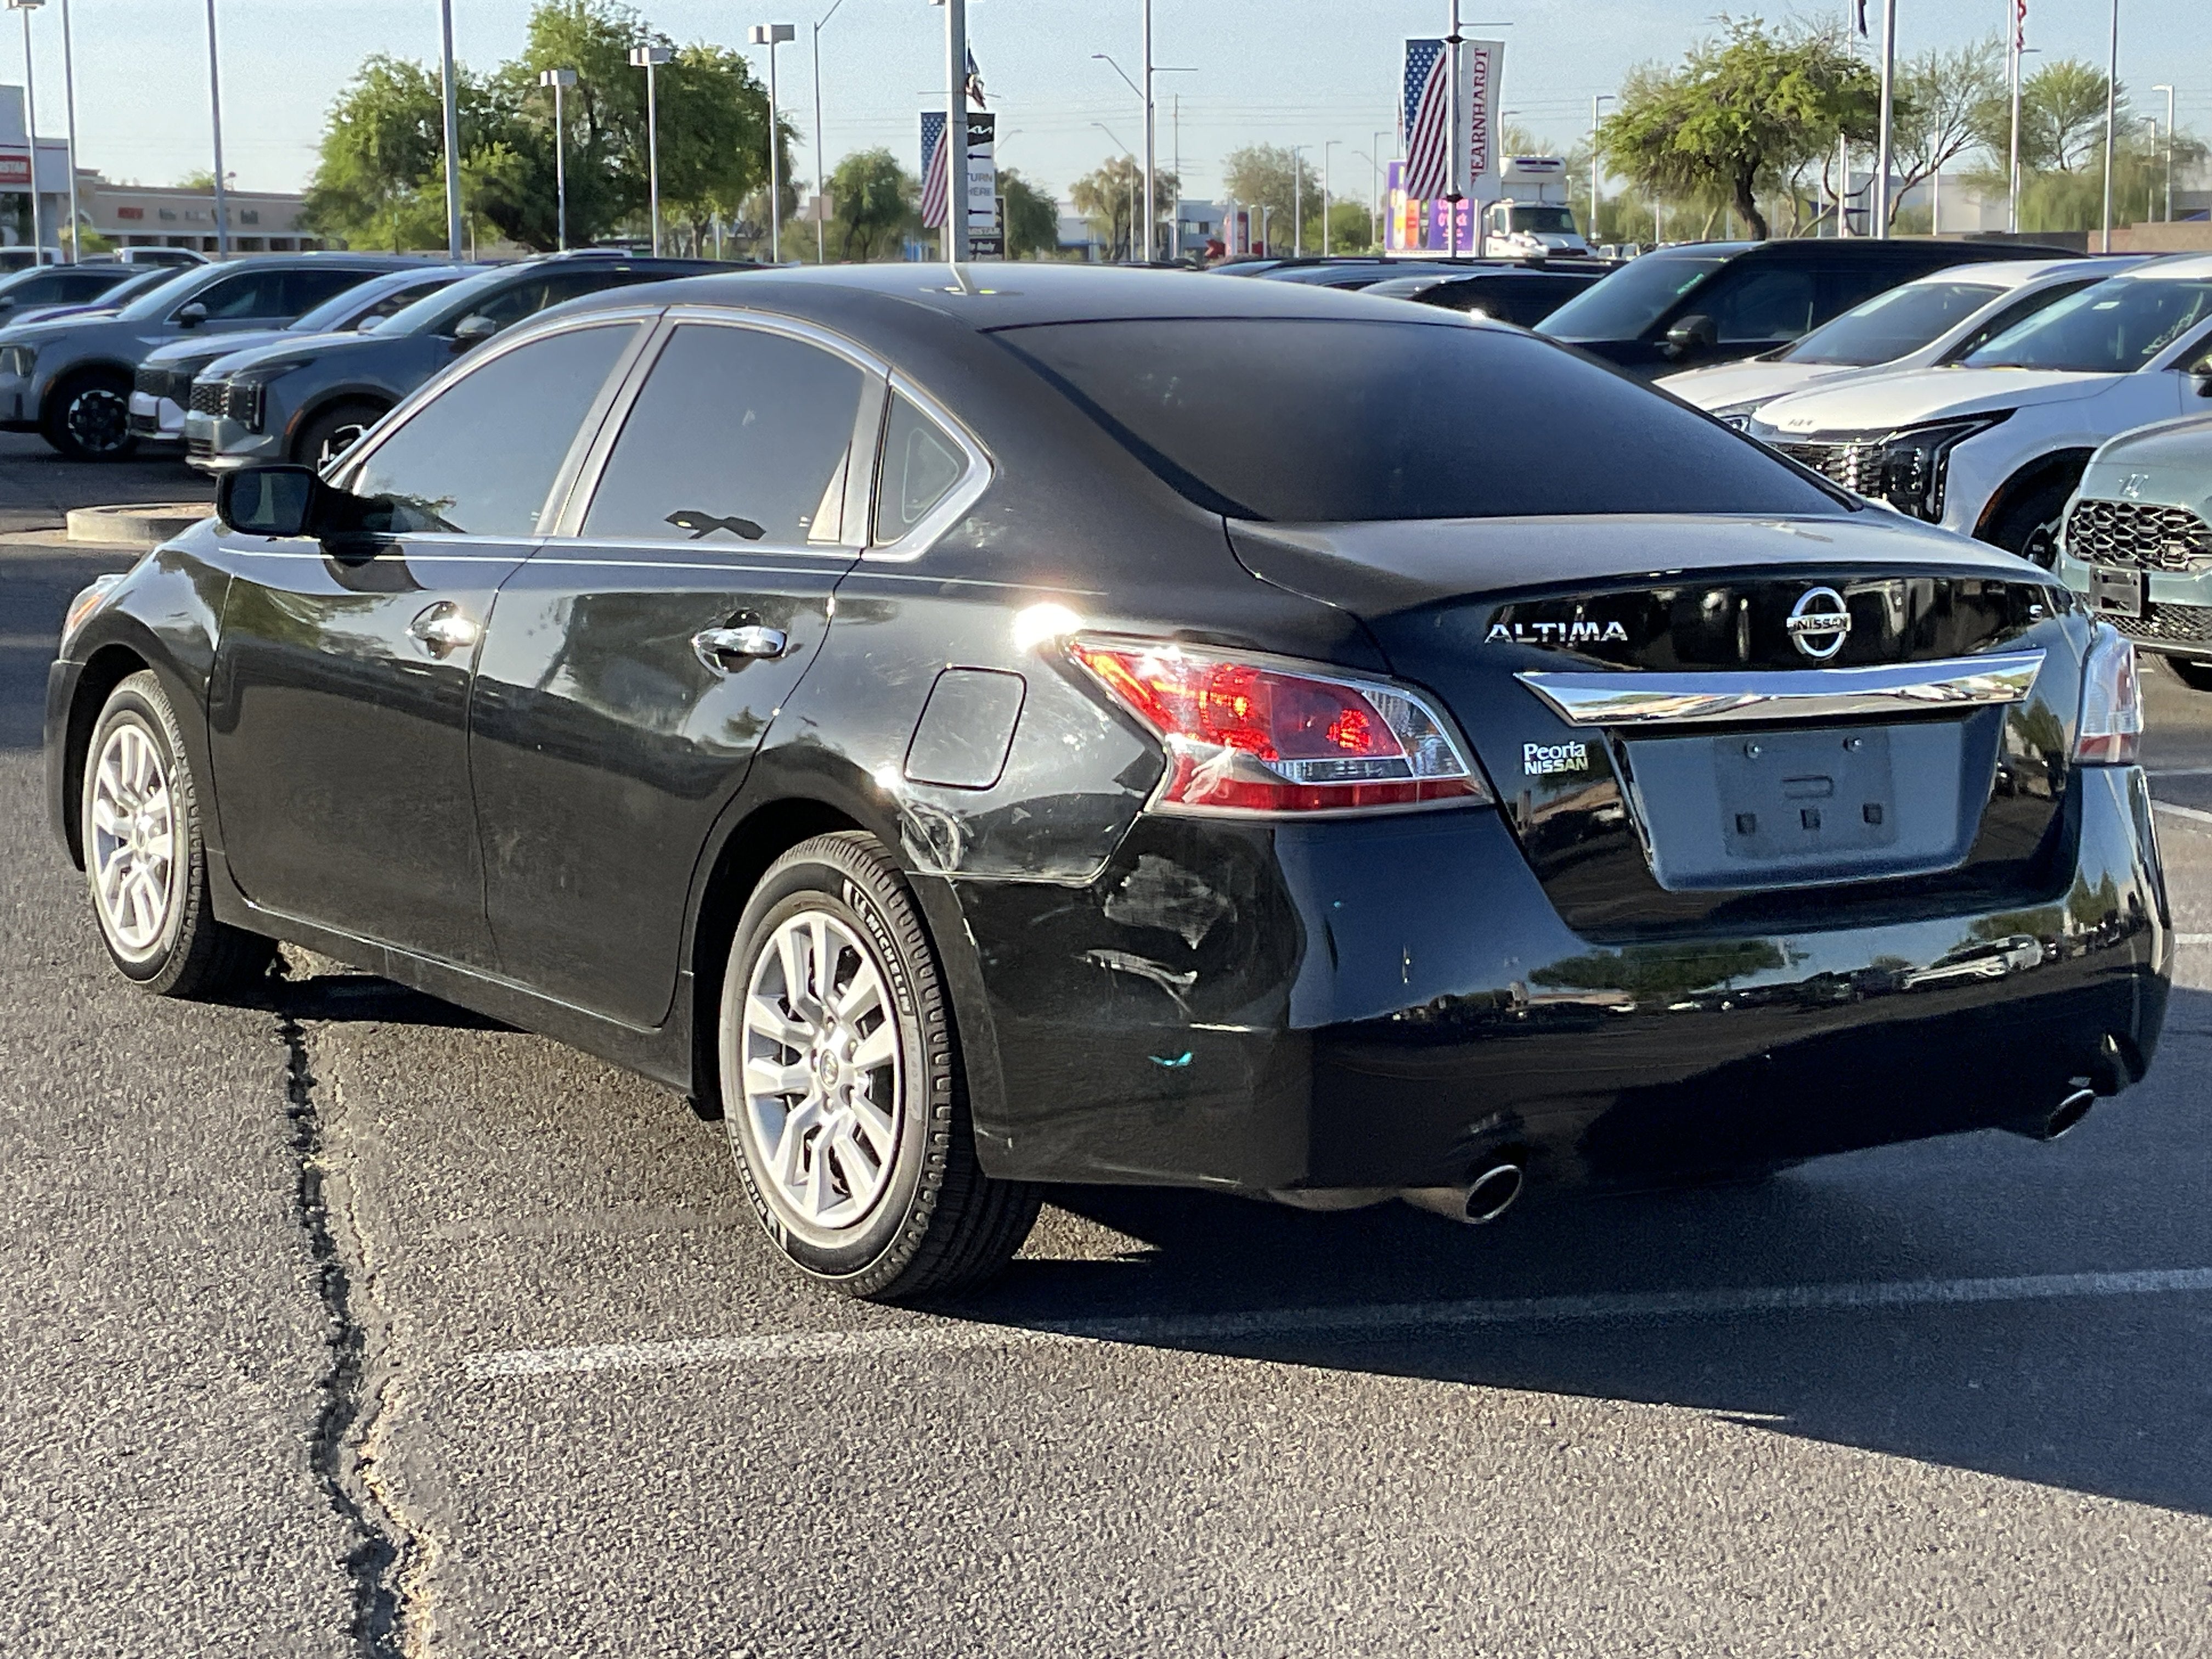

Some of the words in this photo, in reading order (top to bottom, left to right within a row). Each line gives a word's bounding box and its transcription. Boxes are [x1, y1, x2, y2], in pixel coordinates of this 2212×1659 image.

[1470, 48, 1487, 171] EARNHARDT
[1797, 615, 1847, 630] NISSAN
[1484, 622, 1628, 644] ALTIMA
[1523, 741, 1586, 760] Peoria
[1524, 758, 1589, 775] NISSAN
[866, 912, 911, 1012] MICHELIN
